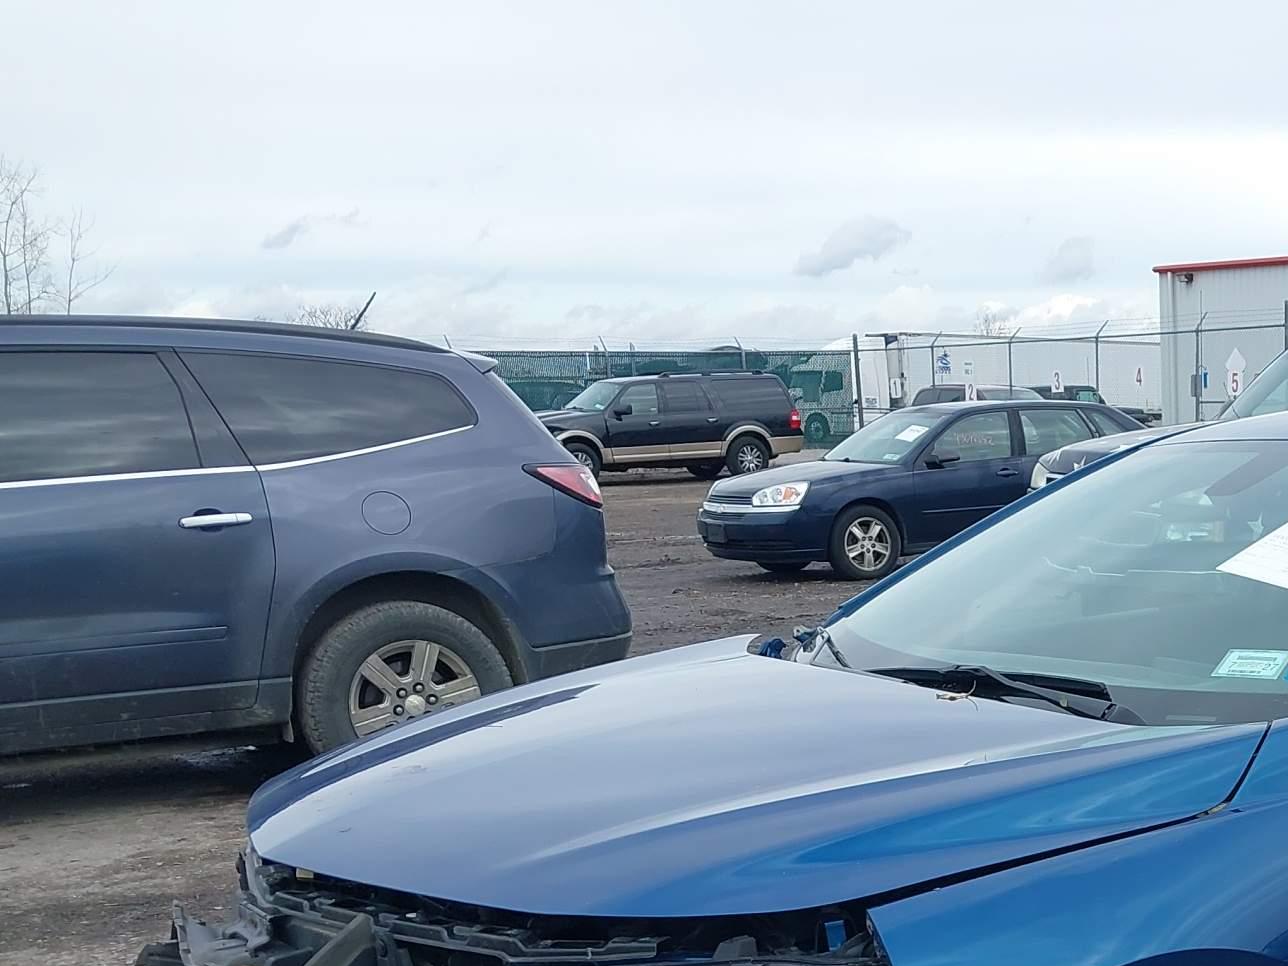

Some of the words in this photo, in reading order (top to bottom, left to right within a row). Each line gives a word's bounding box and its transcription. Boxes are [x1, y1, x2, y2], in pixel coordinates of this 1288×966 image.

[1054, 371, 1061, 390] 3
[1135, 367, 1143, 387] 4
[1231, 372, 1239, 393] 5
[967, 383, 975, 400] 2
